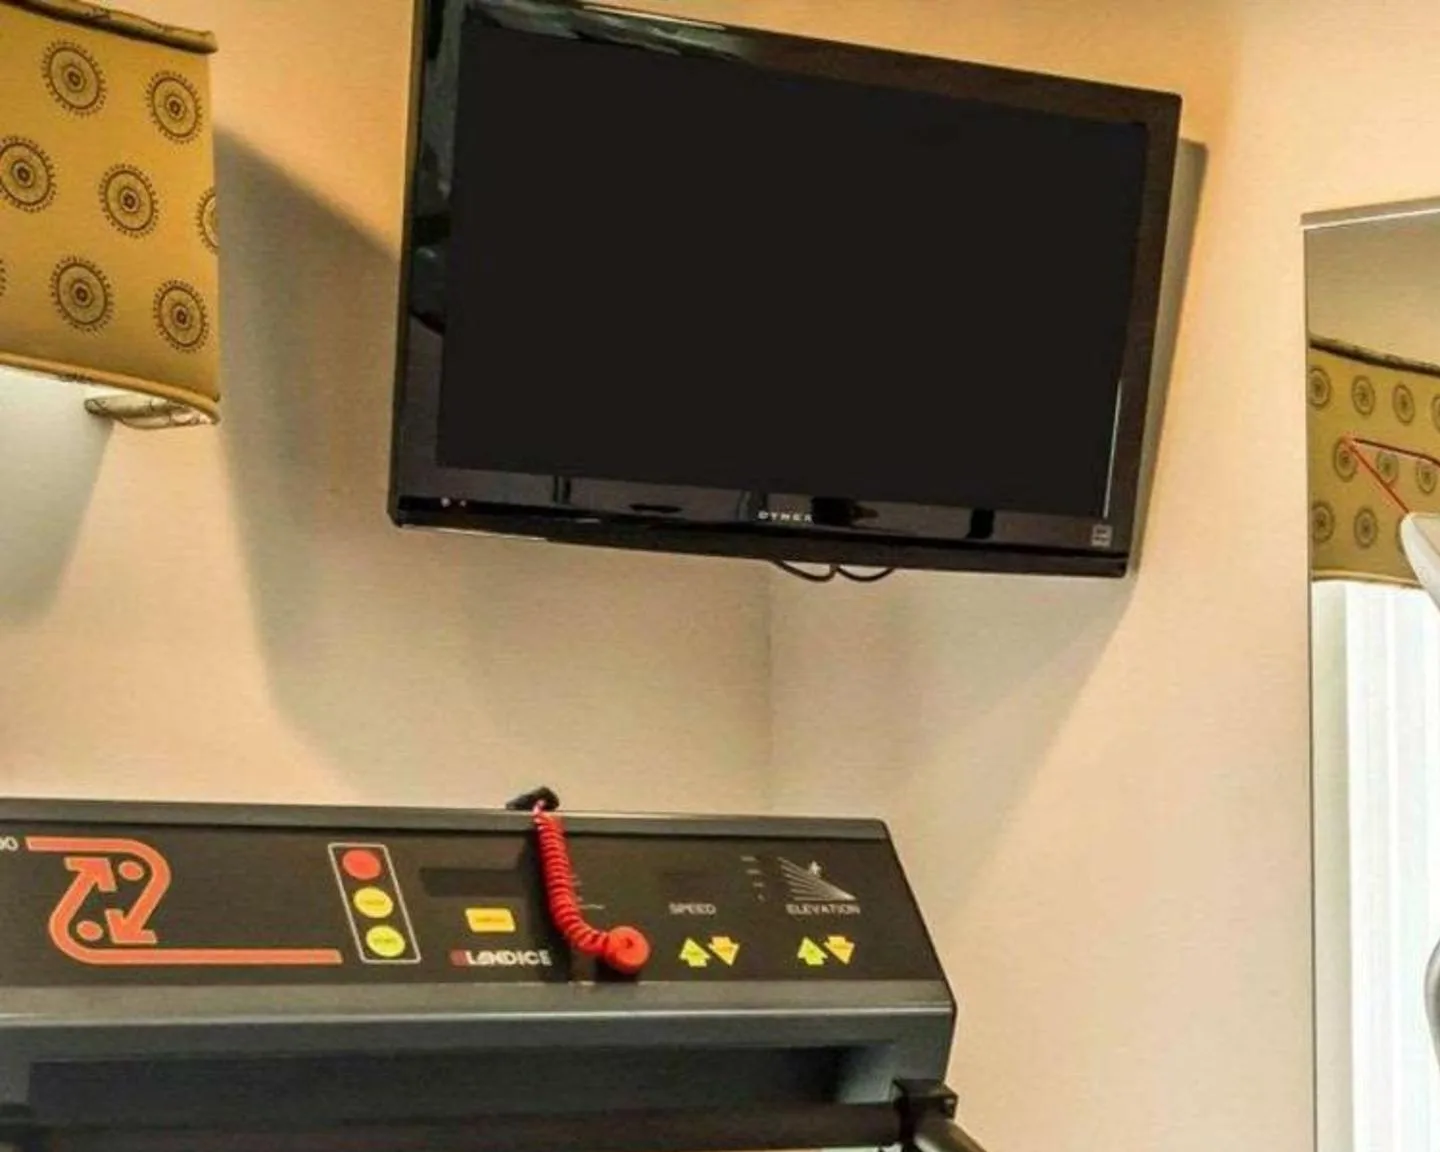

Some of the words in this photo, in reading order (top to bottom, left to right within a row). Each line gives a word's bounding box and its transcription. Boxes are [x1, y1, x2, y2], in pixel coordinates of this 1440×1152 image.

[668, 903, 717, 915] SPEED
[785, 903, 861, 915] ELEVATION
[465, 949, 553, 966] LANDICE
